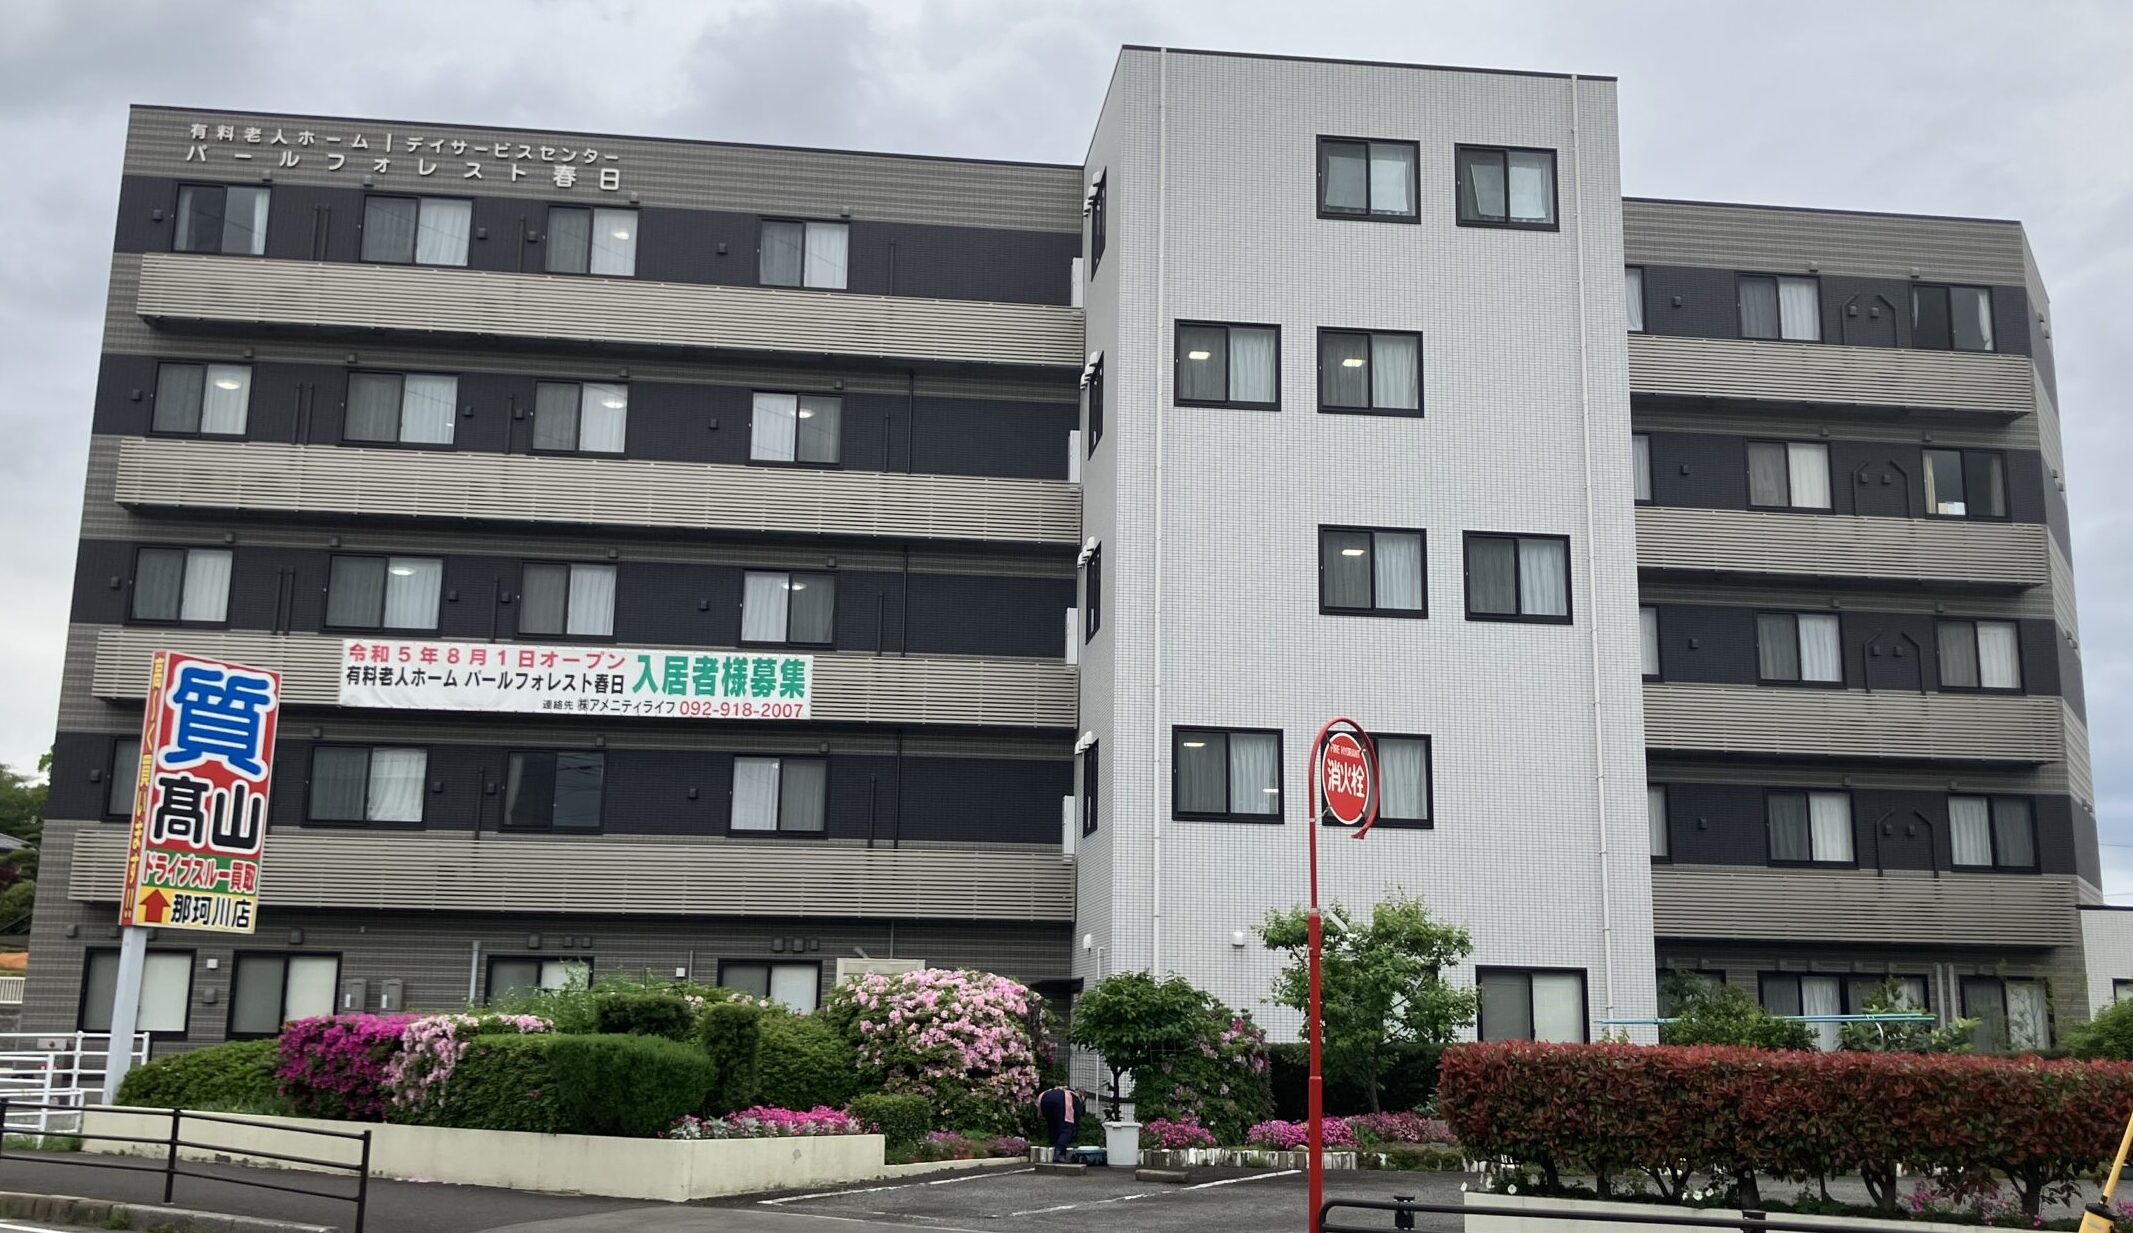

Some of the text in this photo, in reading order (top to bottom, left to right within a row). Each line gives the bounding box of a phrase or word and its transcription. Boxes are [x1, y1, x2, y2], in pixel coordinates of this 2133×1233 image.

[186, 144, 620, 191] パールフォレスト春日
[346, 665, 624, 694] 有料老人ホーム パールフォレスト春日
[633, 655, 806, 698] 入居者様募集
[164, 666, 271, 776] 質
[680, 701, 803, 718] 092-918-2007
[1328, 758, 1365, 798] 消火栓
[143, 852, 256, 892] ドライブスルー買取
[170, 893, 252, 928] 那珂川店
